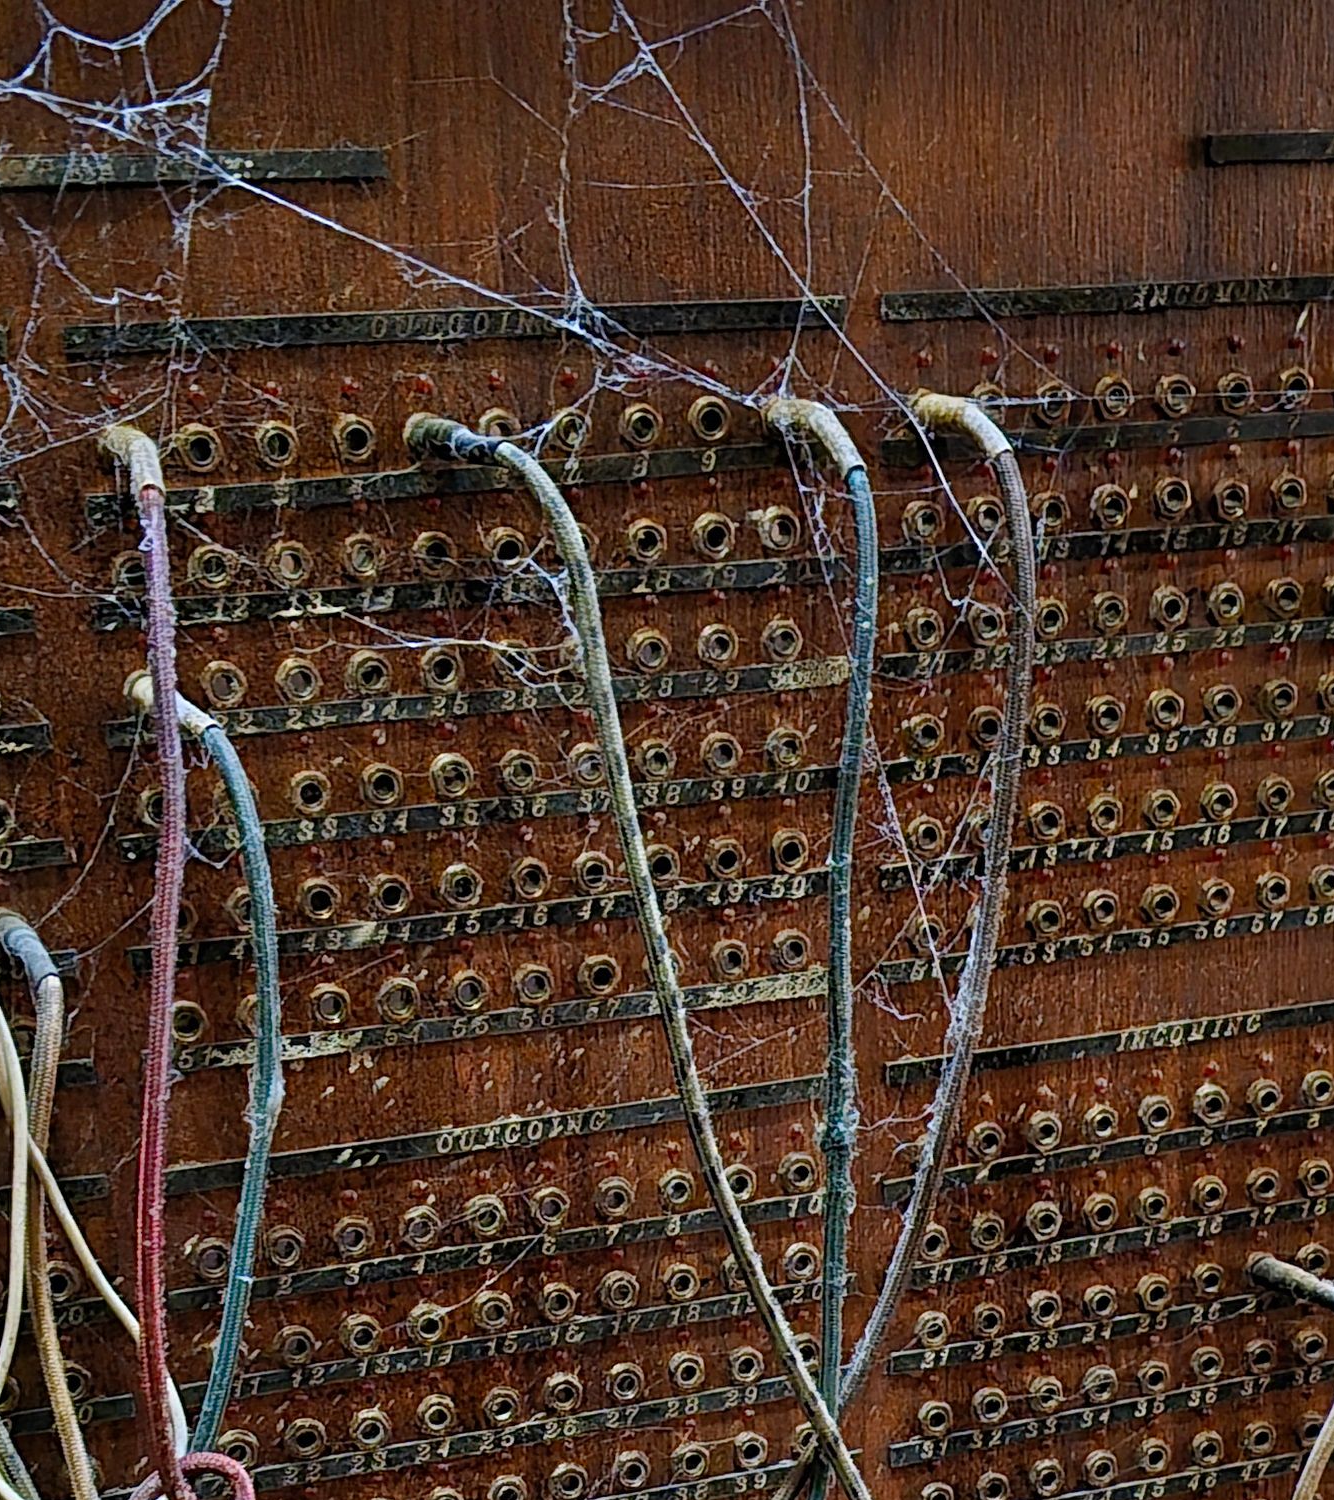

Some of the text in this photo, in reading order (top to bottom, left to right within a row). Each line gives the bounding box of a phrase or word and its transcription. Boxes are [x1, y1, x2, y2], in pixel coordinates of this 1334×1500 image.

[702, 450, 717, 473] 9
[707, 564, 737, 588] 19
[430, 694, 467, 716] 25
[503, 690, 538, 711] 26
[705, 671, 739, 693] 29
[770, 876, 806, 897] 50
[1196, 918, 1227, 940] 56
[1251, 911, 1284, 932] 57
[178, 1047, 212, 1069] 51
[452, 1013, 490, 1036] 55
[519, 1005, 554, 1027] 56
[1118, 1014, 1260, 1050] INCOMING
[436, 1110, 606, 1153] OUTGOING
[276, 1276, 293, 1296] 2
[477, 1245, 492, 1265] 5
[606, 1225, 621, 1245] 7
[235, 1374, 260, 1396] 11
[486, 1335, 518, 1356] 15
[611, 1314, 641, 1335] 17
[671, 1304, 701, 1323] 18
[284, 1464, 321, 1485] 22
[480, 1428, 516, 1450] 25
[543, 1417, 578, 1439] 26
[607, 1407, 638, 1427] 27
[666, 1398, 699, 1418] 28
[726, 1388, 758, 1408] 29
